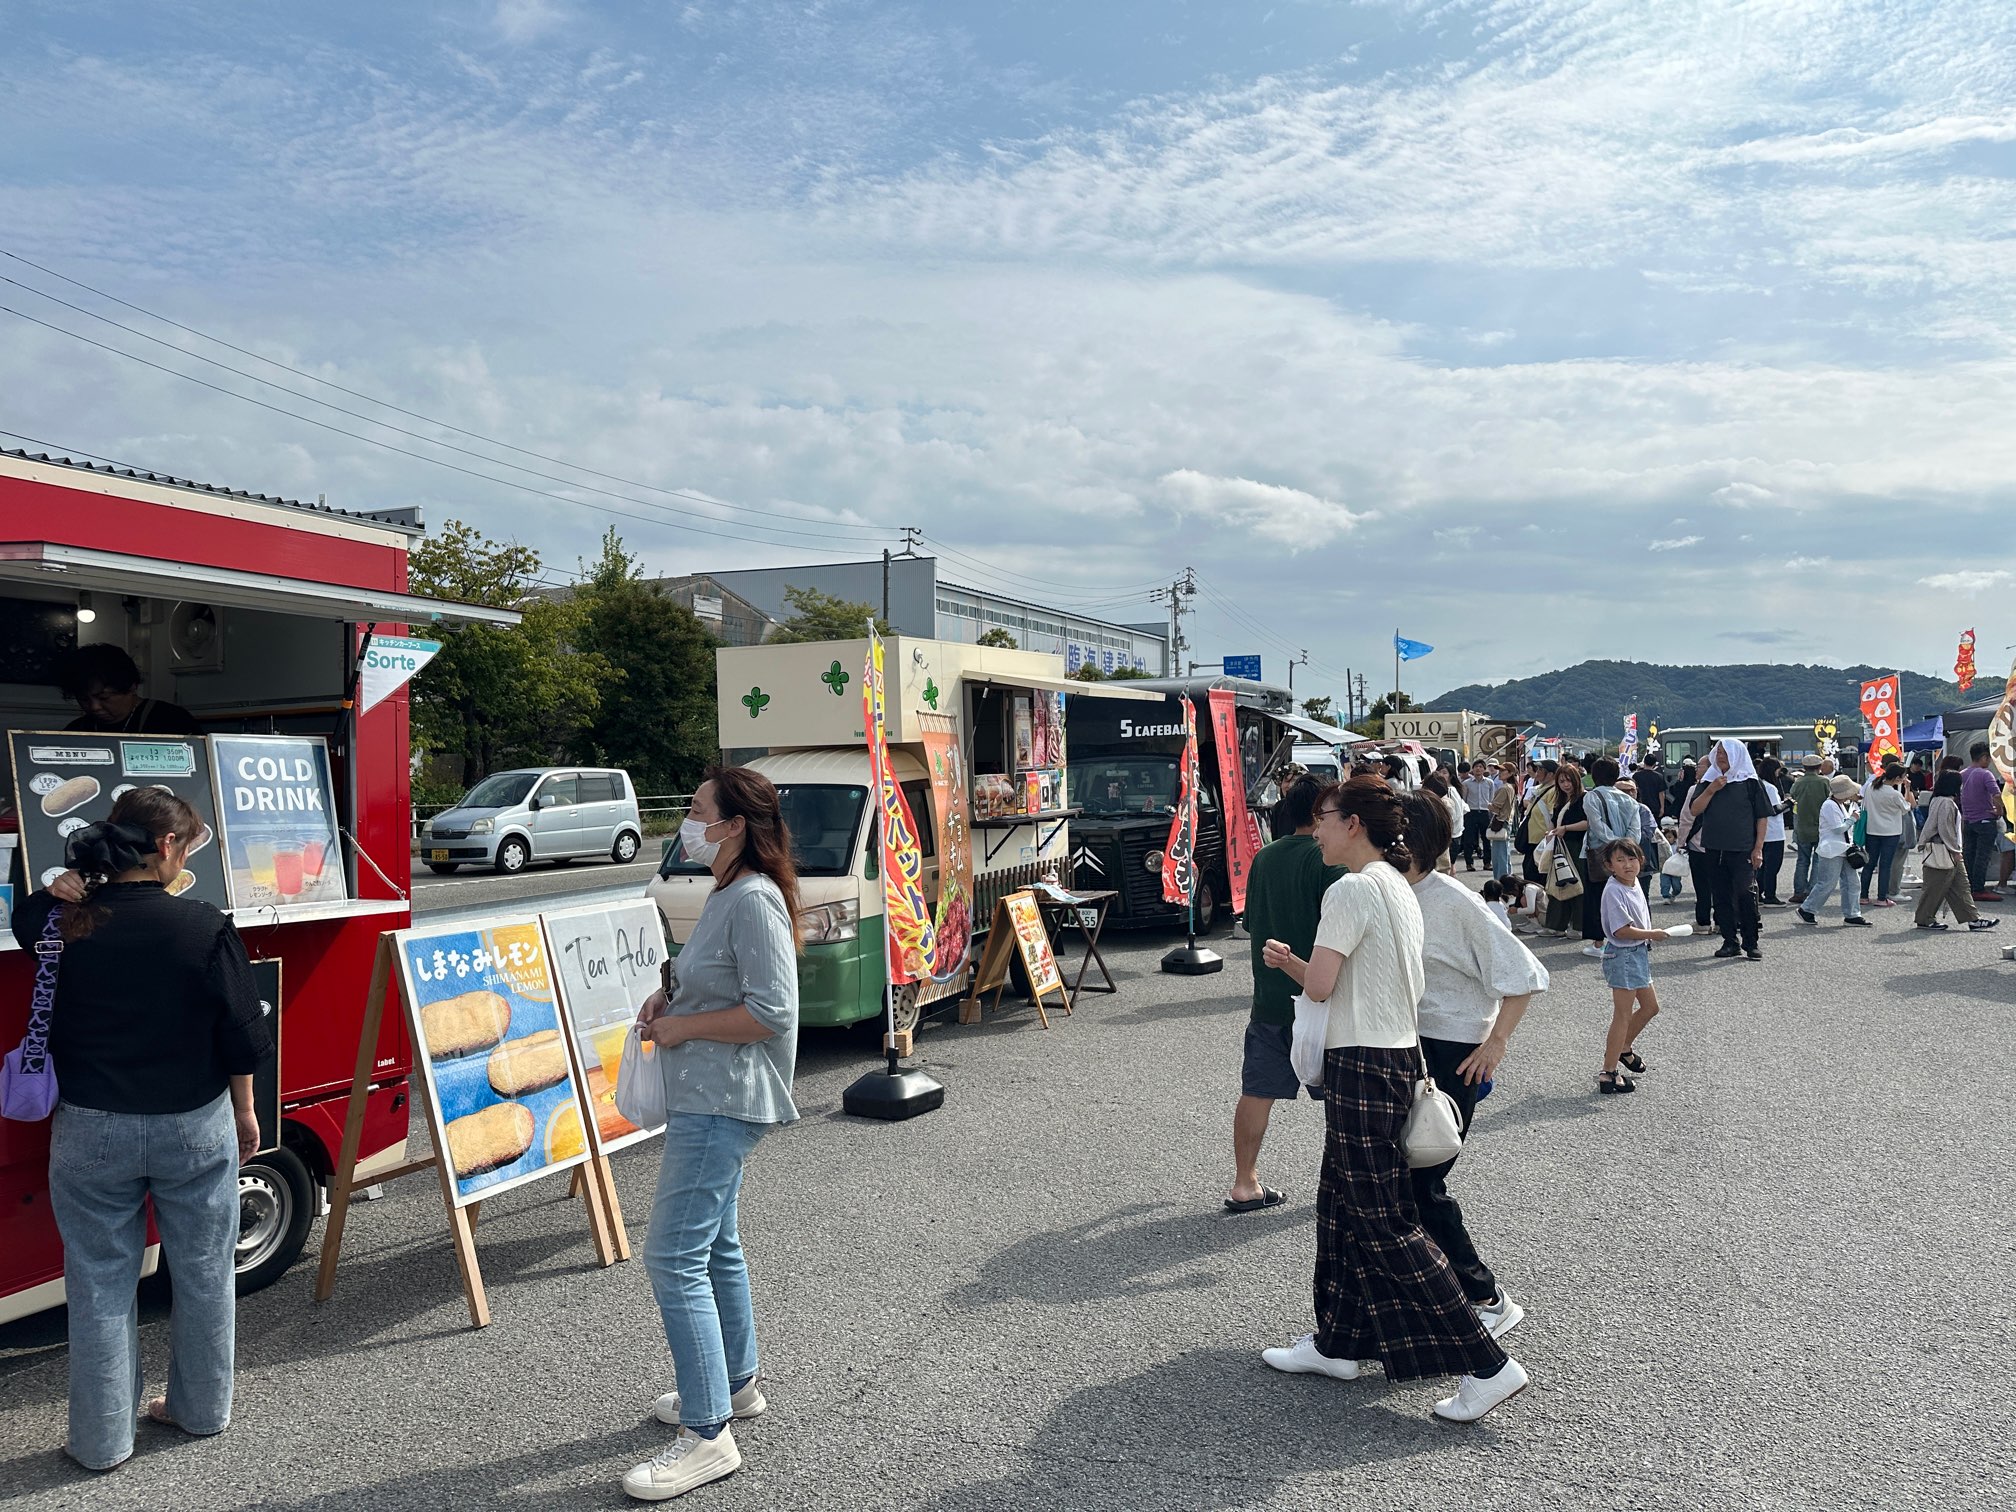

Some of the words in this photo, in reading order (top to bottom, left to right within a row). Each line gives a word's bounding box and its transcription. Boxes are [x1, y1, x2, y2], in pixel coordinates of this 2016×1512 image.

[366, 650, 416, 671] Sorte
[1121, 719, 1133, 738] 5
[1390, 721, 1441, 736] YOLO
[238, 757, 313, 781] COLD
[235, 787, 323, 811] DRINK
[416, 941, 539, 982] しまなみレモン
[482, 967, 543, 987] SHIMANAMI
[511, 979, 545, 994] LEMON
